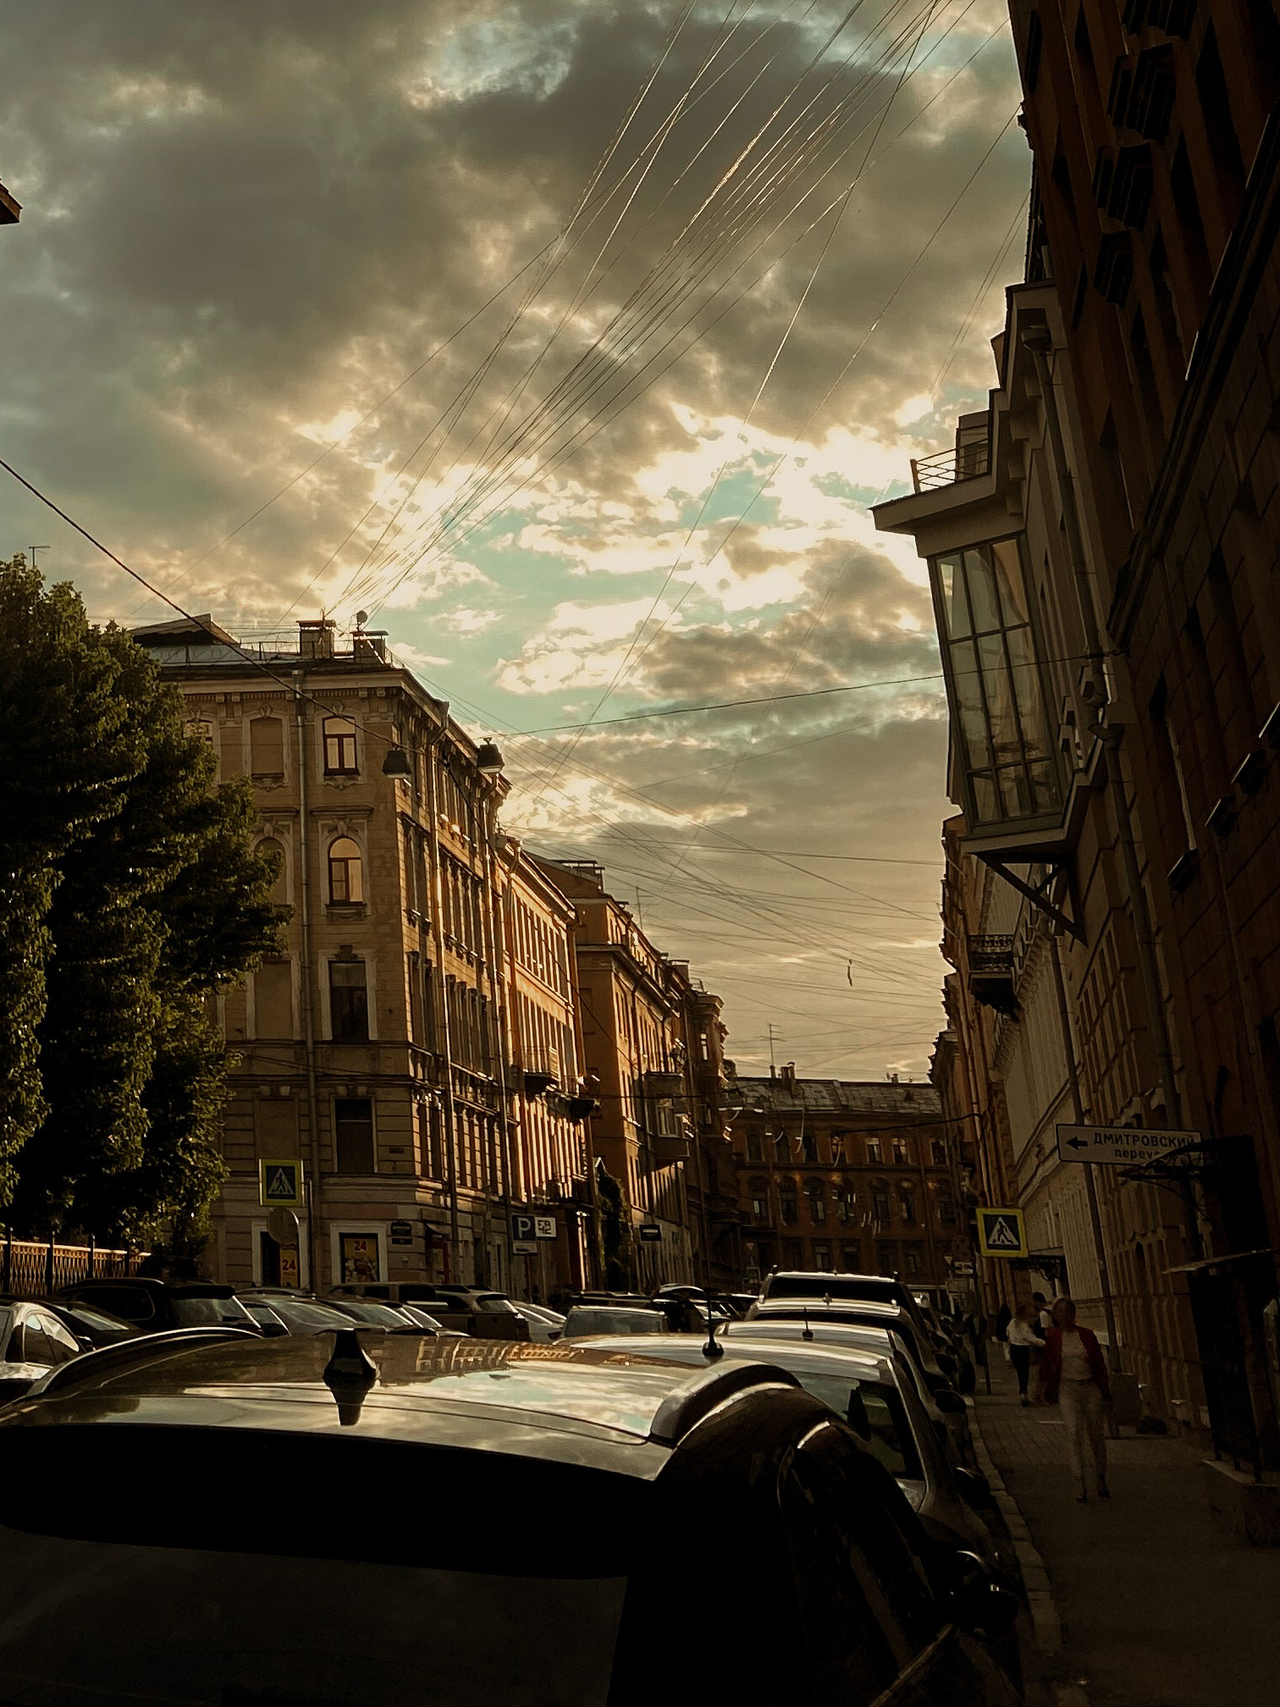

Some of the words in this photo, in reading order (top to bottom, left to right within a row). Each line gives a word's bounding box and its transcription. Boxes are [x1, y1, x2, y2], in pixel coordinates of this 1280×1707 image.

[1093, 1132, 1195, 1148] ДМИТРОВСКИЙ
[1114, 1148, 1160, 1161] переу
[518, 1217, 531, 1238] P
[354, 1240, 367, 1251] 24
[282, 1259, 296, 1271] 24
